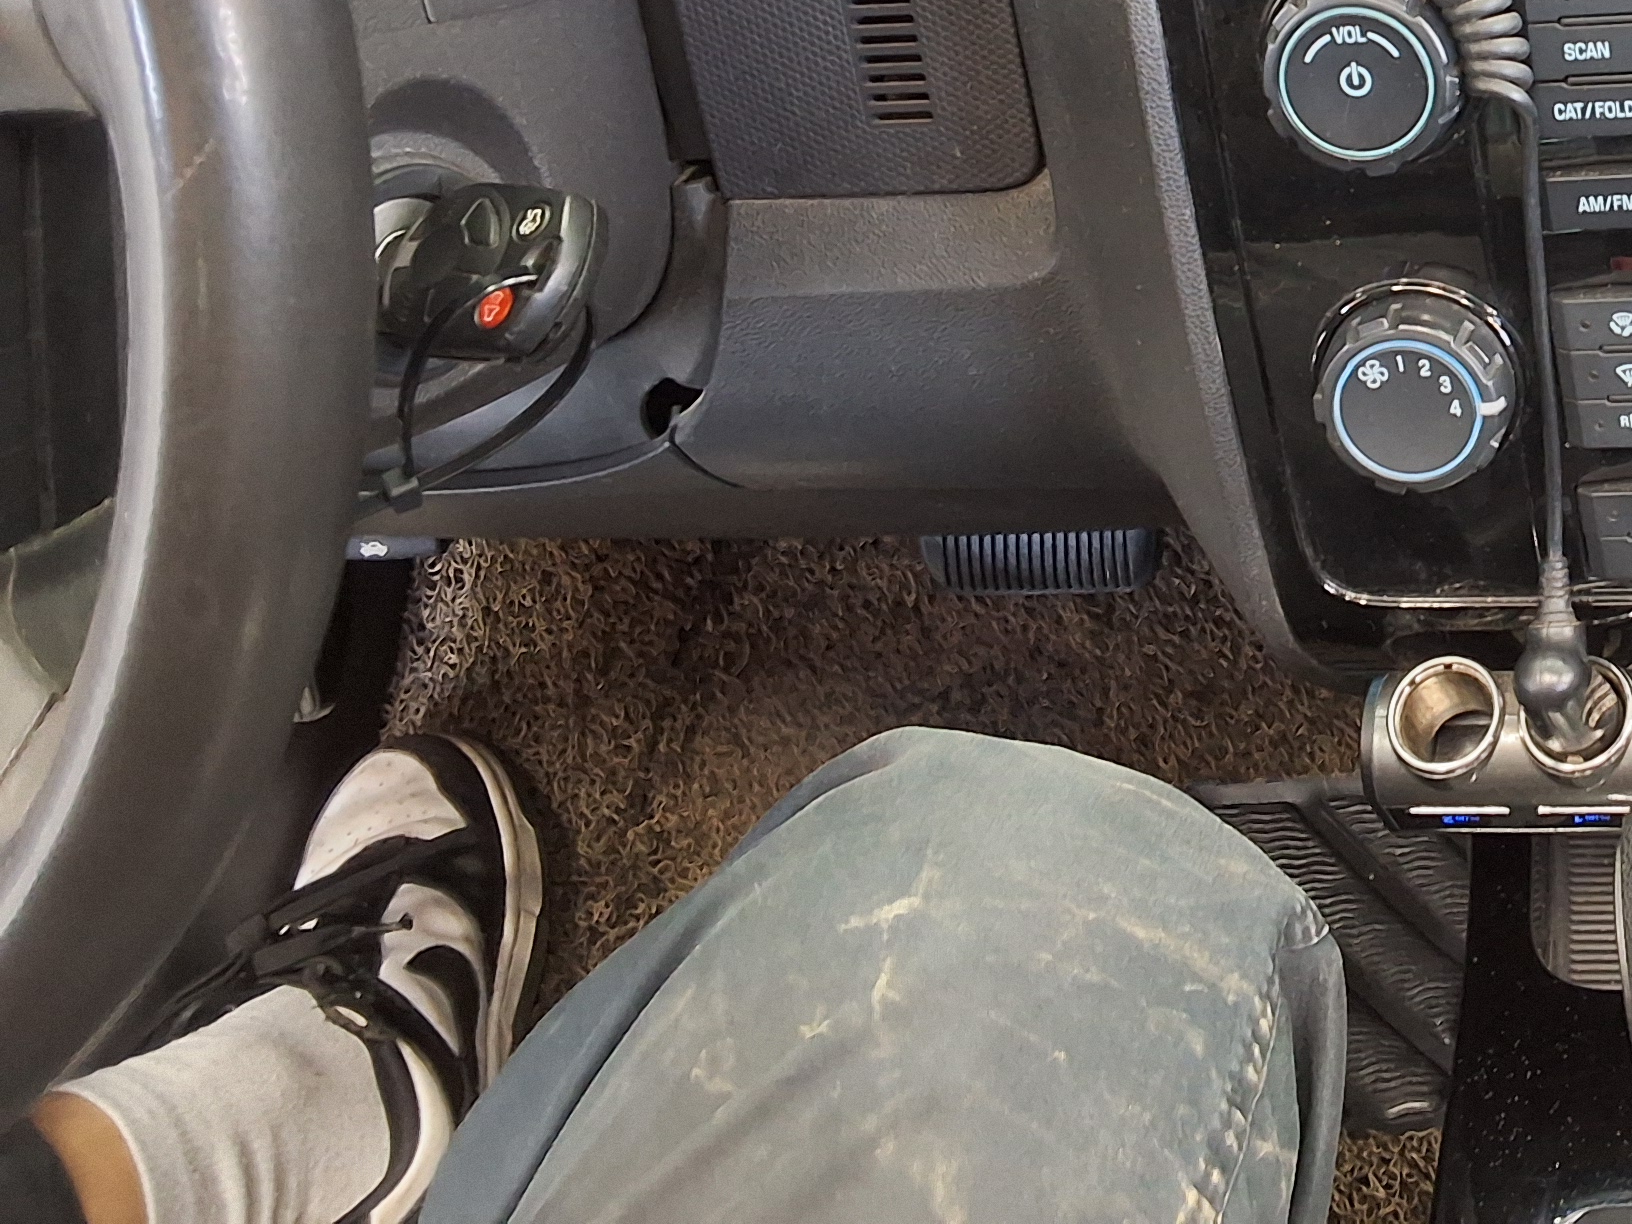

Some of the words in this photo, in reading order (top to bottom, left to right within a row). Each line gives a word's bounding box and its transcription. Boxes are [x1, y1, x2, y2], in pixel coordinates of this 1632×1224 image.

[1331, 25, 1368, 44] VOL
[1563, 41, 1610, 61] SCAN
[1396, 355, 1404, 372] 1
[1418, 359, 1431, 377] 2
[1439, 376, 1452, 394] 3
[1449, 399, 1462, 417] 4
[1620, 415, 1629, 428] R
